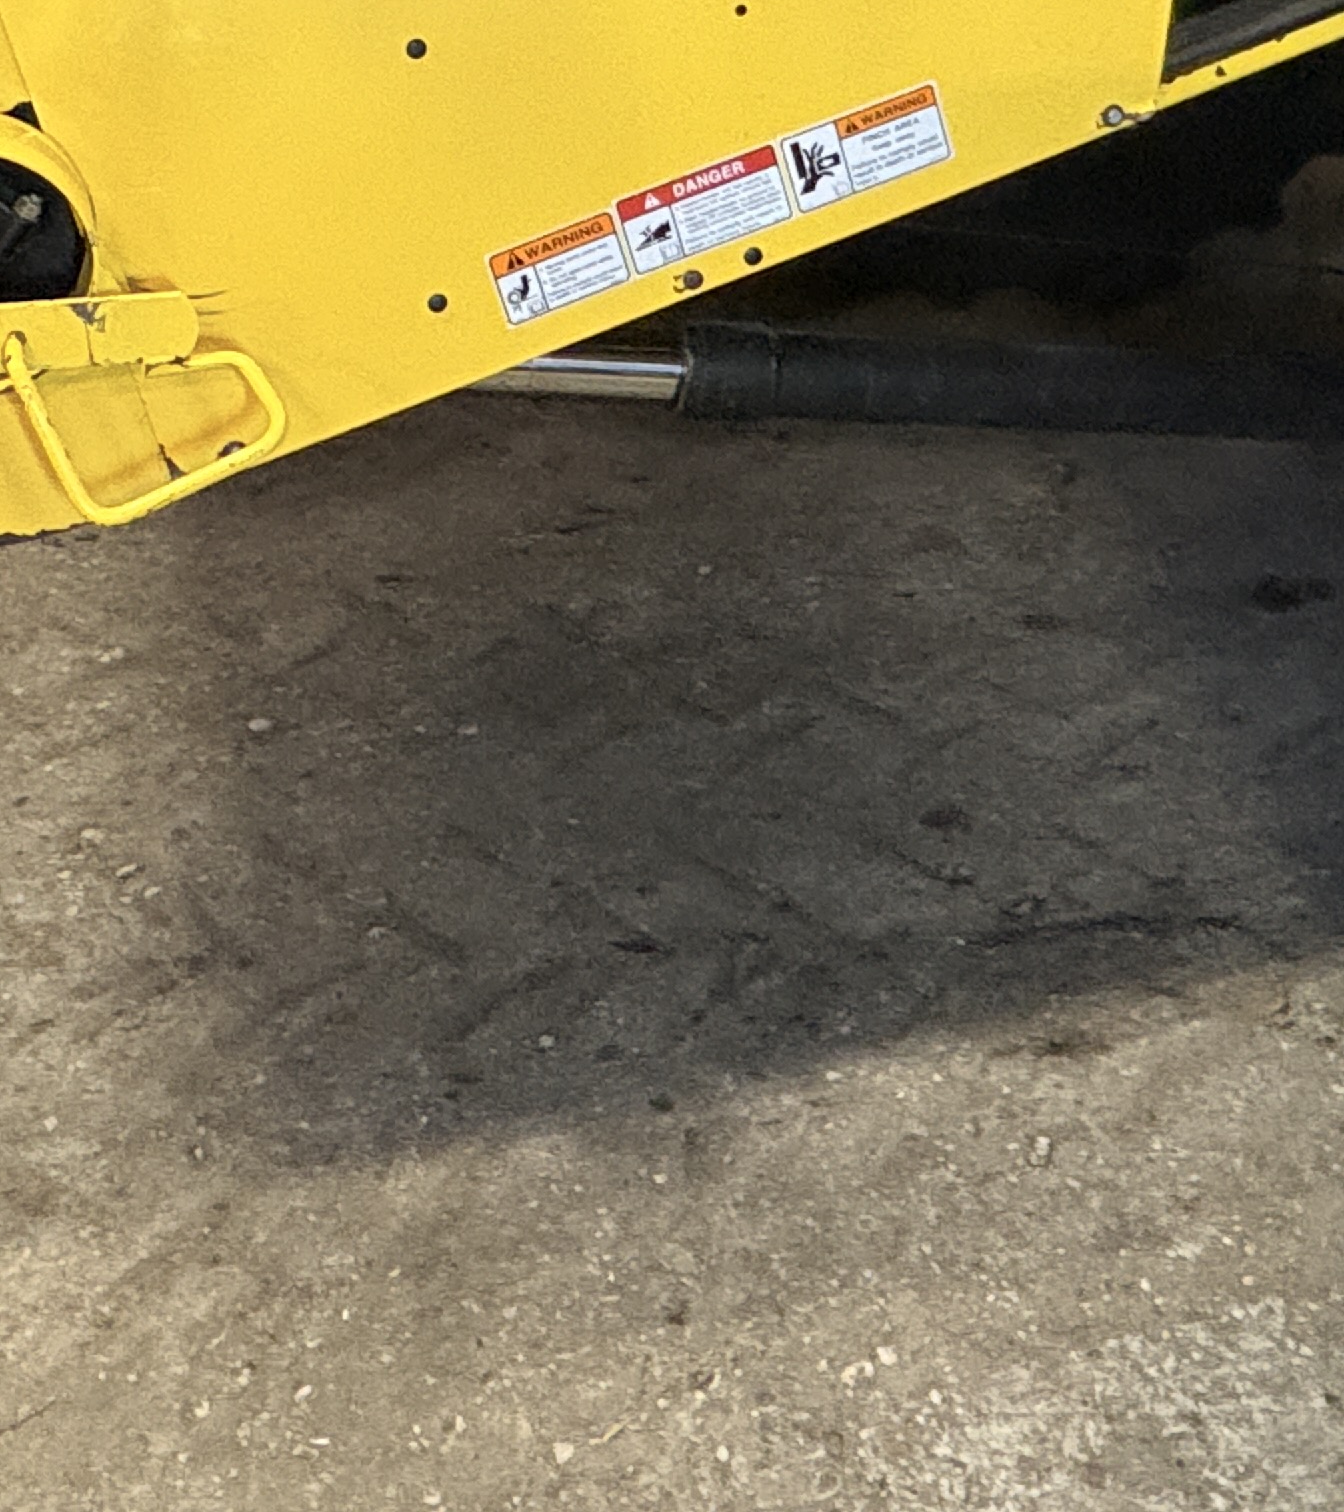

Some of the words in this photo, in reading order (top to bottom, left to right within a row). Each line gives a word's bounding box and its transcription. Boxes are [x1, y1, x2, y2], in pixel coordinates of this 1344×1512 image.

[860, 92, 928, 126] WARNING
[672, 160, 746, 198] DANGER
[524, 221, 604, 260] WARNING
